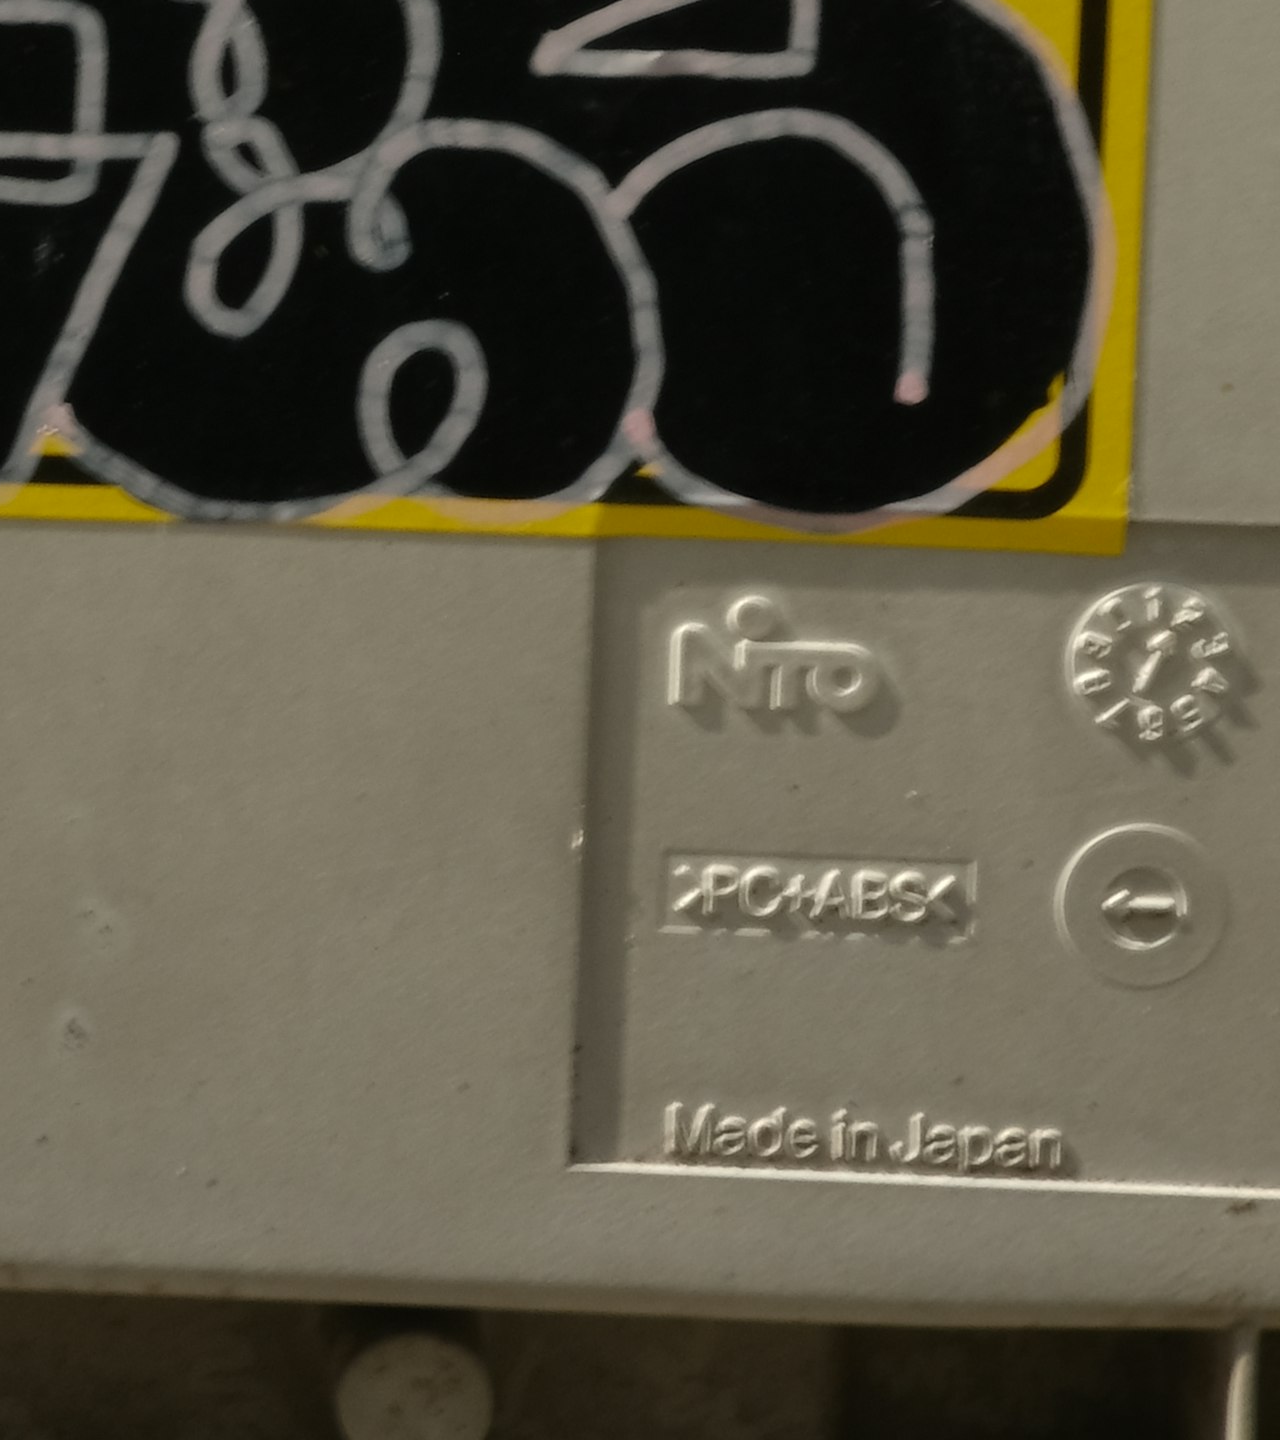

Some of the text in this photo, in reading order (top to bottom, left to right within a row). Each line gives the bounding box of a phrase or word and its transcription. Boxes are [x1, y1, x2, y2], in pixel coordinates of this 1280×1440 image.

[662, 1100, 1063, 1171] Made in Japan
